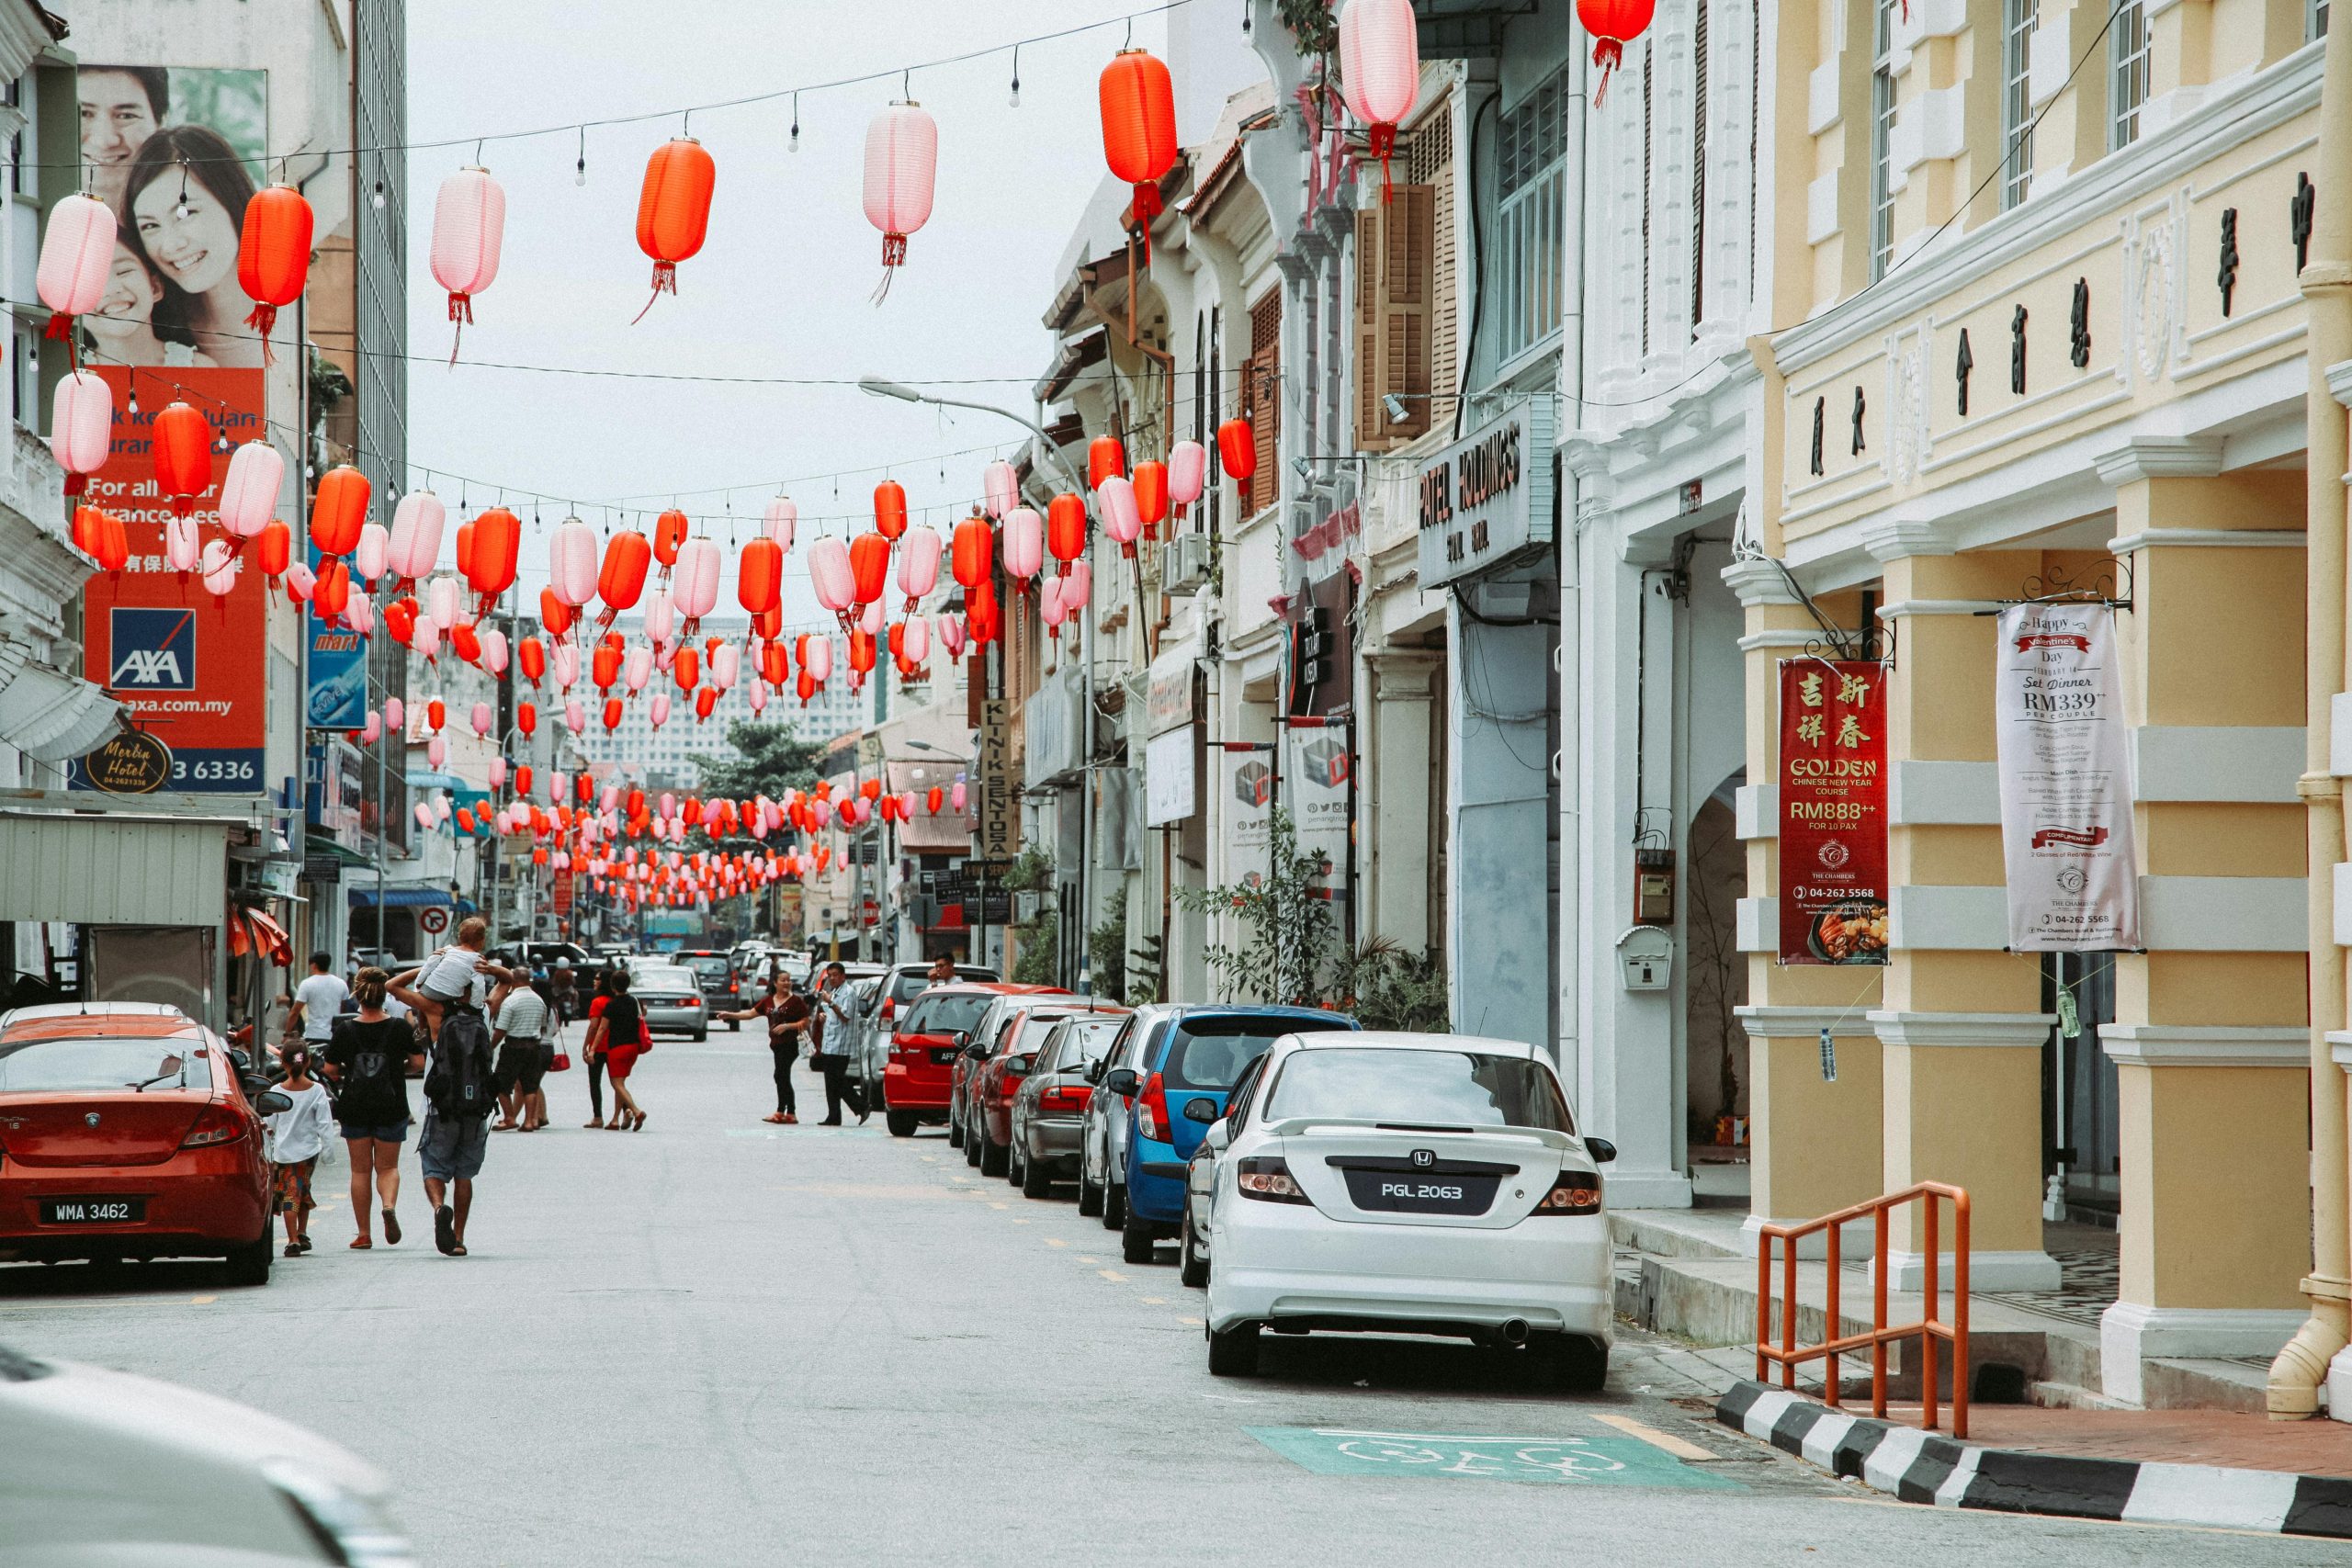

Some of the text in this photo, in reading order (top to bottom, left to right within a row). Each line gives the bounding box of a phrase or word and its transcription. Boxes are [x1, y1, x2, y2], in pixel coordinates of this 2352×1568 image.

[1419, 420, 1520, 529] PATEL HOLDINGS
[87, 478, 127, 497] For
[131, 479, 158, 497] all
[2032, 617, 2069, 632] Happy
[313, 633, 360, 652] mart
[2029, 637, 2075, 646] Valentine's
[2041, 651, 2064, 664] Day
[111, 649, 184, 684] AXA
[2033, 667, 2065, 676] FEBRUARY
[2023, 676, 2093, 690] Set Dinner
[2050, 710, 2096, 719] COUPLE
[986, 704, 1005, 772] KLINIK
[104, 741, 151, 760] Merlin
[107, 759, 147, 777] Hotel
[194, 761, 254, 780] 6336
[1790, 759, 1877, 777] GOLDEN
[1792, 778, 1827, 786] CHINESE
[1815, 787, 1849, 795] COURSE
[988, 775, 1007, 854] SENTOSA
[1791, 802, 1876, 819] RM888++
[2046, 832, 2094, 843] COMPLIMENTARY
[1810, 888, 1874, 897] 04-262 5568
[2087, 915, 2109, 923] 5568
[1382, 1183, 1463, 1200] PGL 2063
[56, 1203, 129, 1220] WMA 3462
